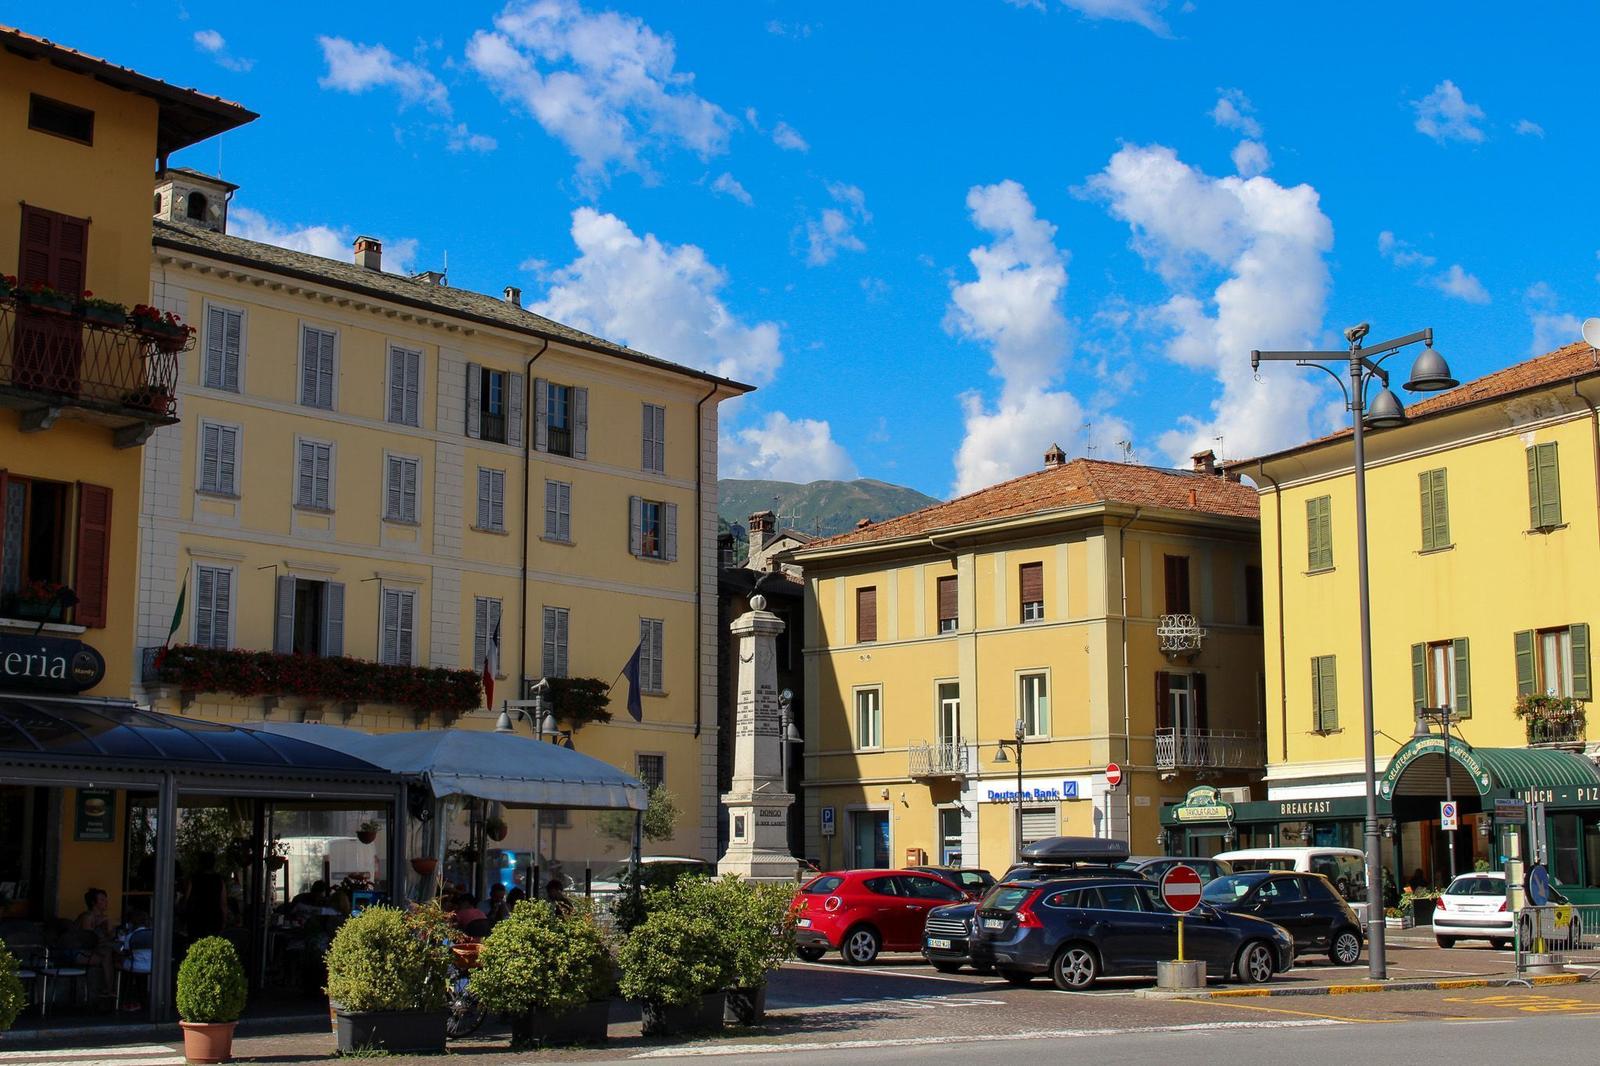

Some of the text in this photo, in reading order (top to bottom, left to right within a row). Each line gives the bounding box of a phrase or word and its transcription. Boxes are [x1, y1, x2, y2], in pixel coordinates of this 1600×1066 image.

[0, 647, 67, 680] eria
[1388, 749, 1413, 781] GELATERIA
[1033, 788, 1057, 799] Bank
[1577, 787, 1599, 801] PIZ
[759, 808, 782, 818] DONGO
[1280, 801, 1330, 815] BREAKFAST
